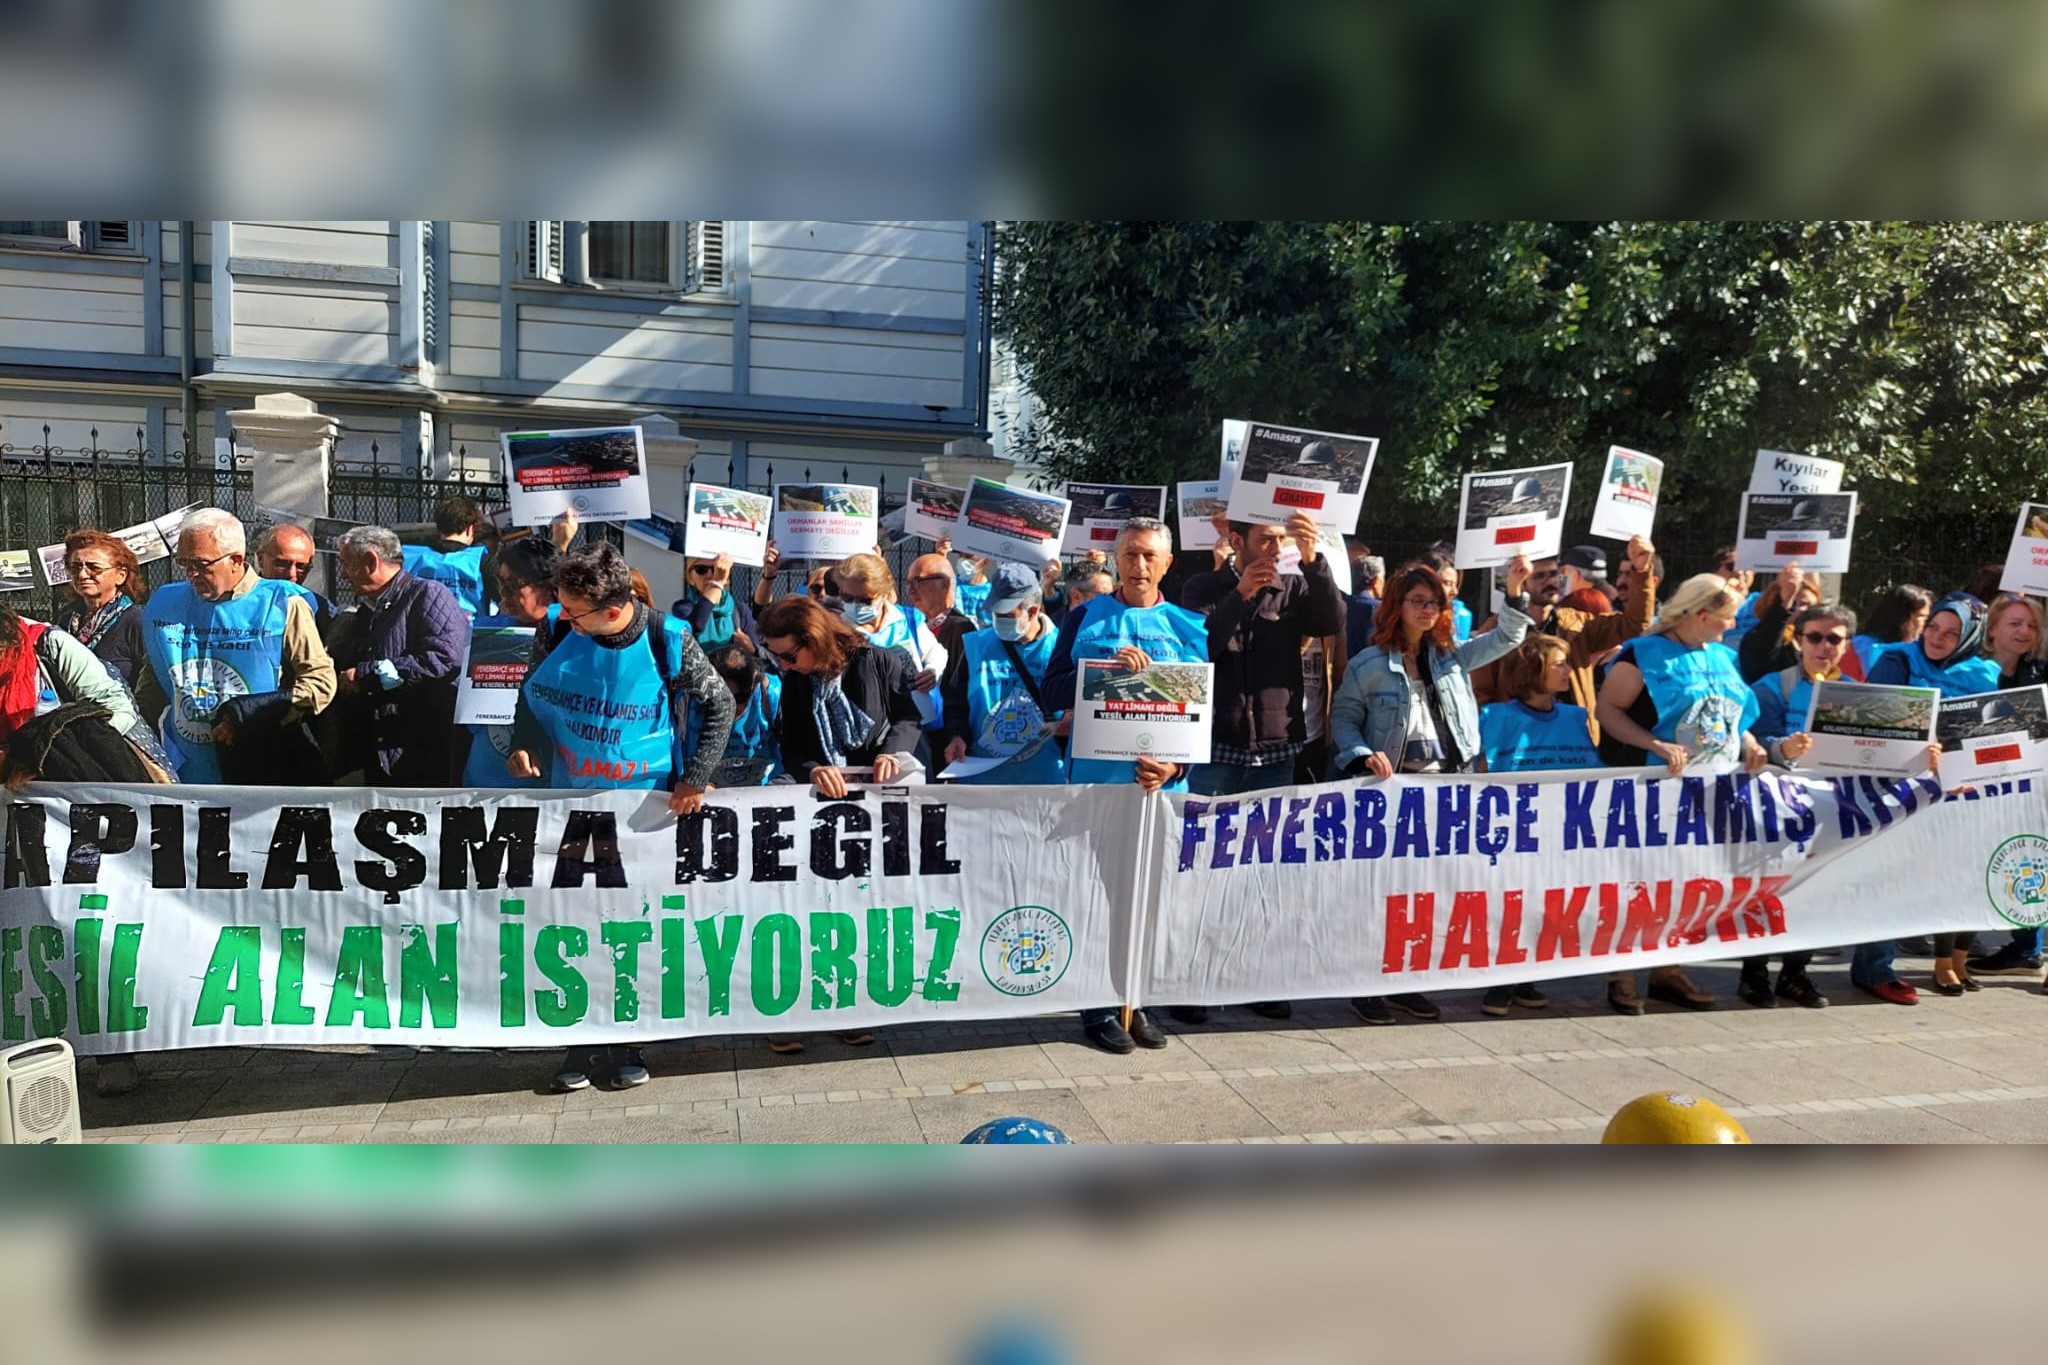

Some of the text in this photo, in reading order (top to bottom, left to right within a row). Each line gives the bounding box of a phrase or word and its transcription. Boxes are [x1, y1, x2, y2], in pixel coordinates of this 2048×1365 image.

[1255, 428, 1302, 444] #Amasra
[1773, 457, 1829, 478] Kıyılar
[1473, 476, 1514, 488] #Amasra
[1069, 485, 1105, 496] #Amasra
[787, 517, 828, 526] ORMANLAR
[583, 696, 597, 714] VE
[595, 698, 639, 726] KALAMIŞ
[1108, 702, 1180, 713] YAT LİMANI DEĞİL
[475, 713, 512, 721] FENERBAHÇE
[1125, 713, 1146, 721] ALAN
[1094, 749, 1129, 757] FENERBAHÇE
[1178, 784, 1538, 873] FENERBAHÇE
[1563, 773, 1816, 853] KALAMIŞ
[675, 786, 962, 885] DEĞİL
[192, 919, 459, 1029] ALAN
[500, 895, 961, 1028] İSTİYORUZ
